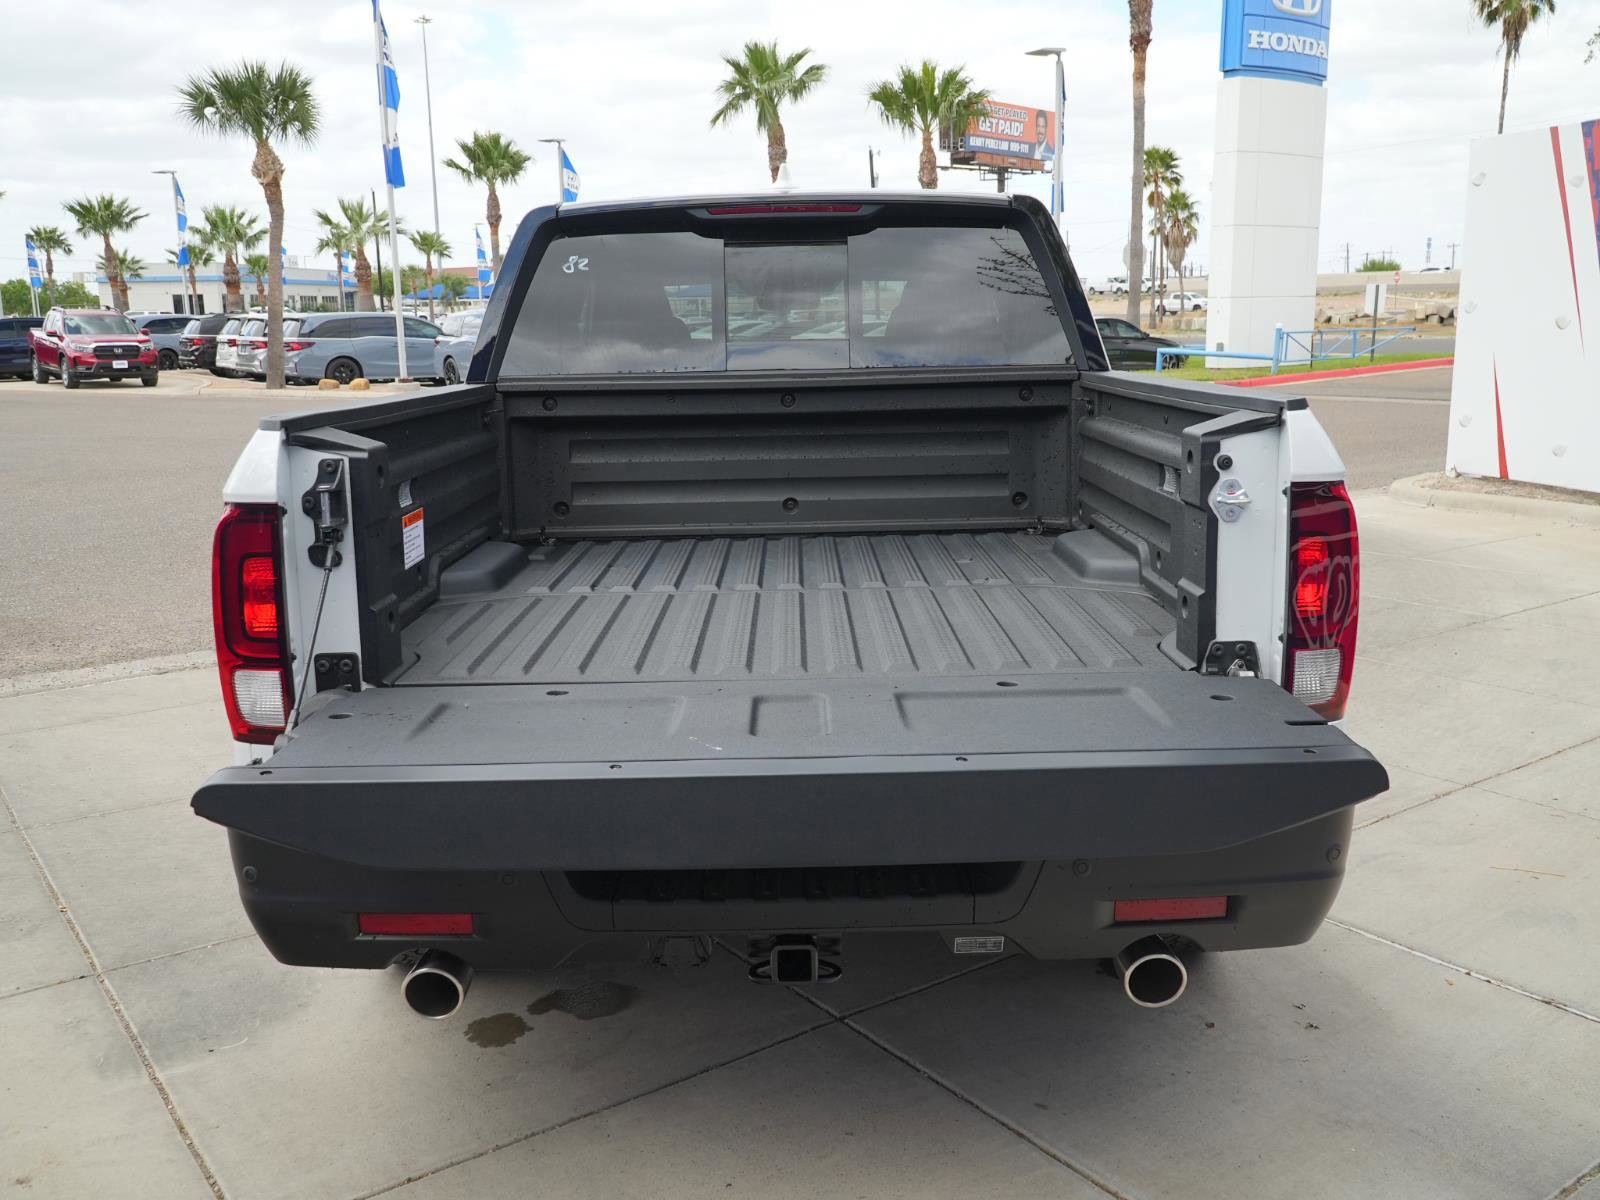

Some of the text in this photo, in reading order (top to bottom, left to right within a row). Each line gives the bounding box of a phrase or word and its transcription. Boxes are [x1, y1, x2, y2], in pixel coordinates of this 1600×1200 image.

[1248, 30, 1328, 59] HONDA
[979, 116, 1024, 137] GET PAID!
[563, 255, 589, 273] 82
